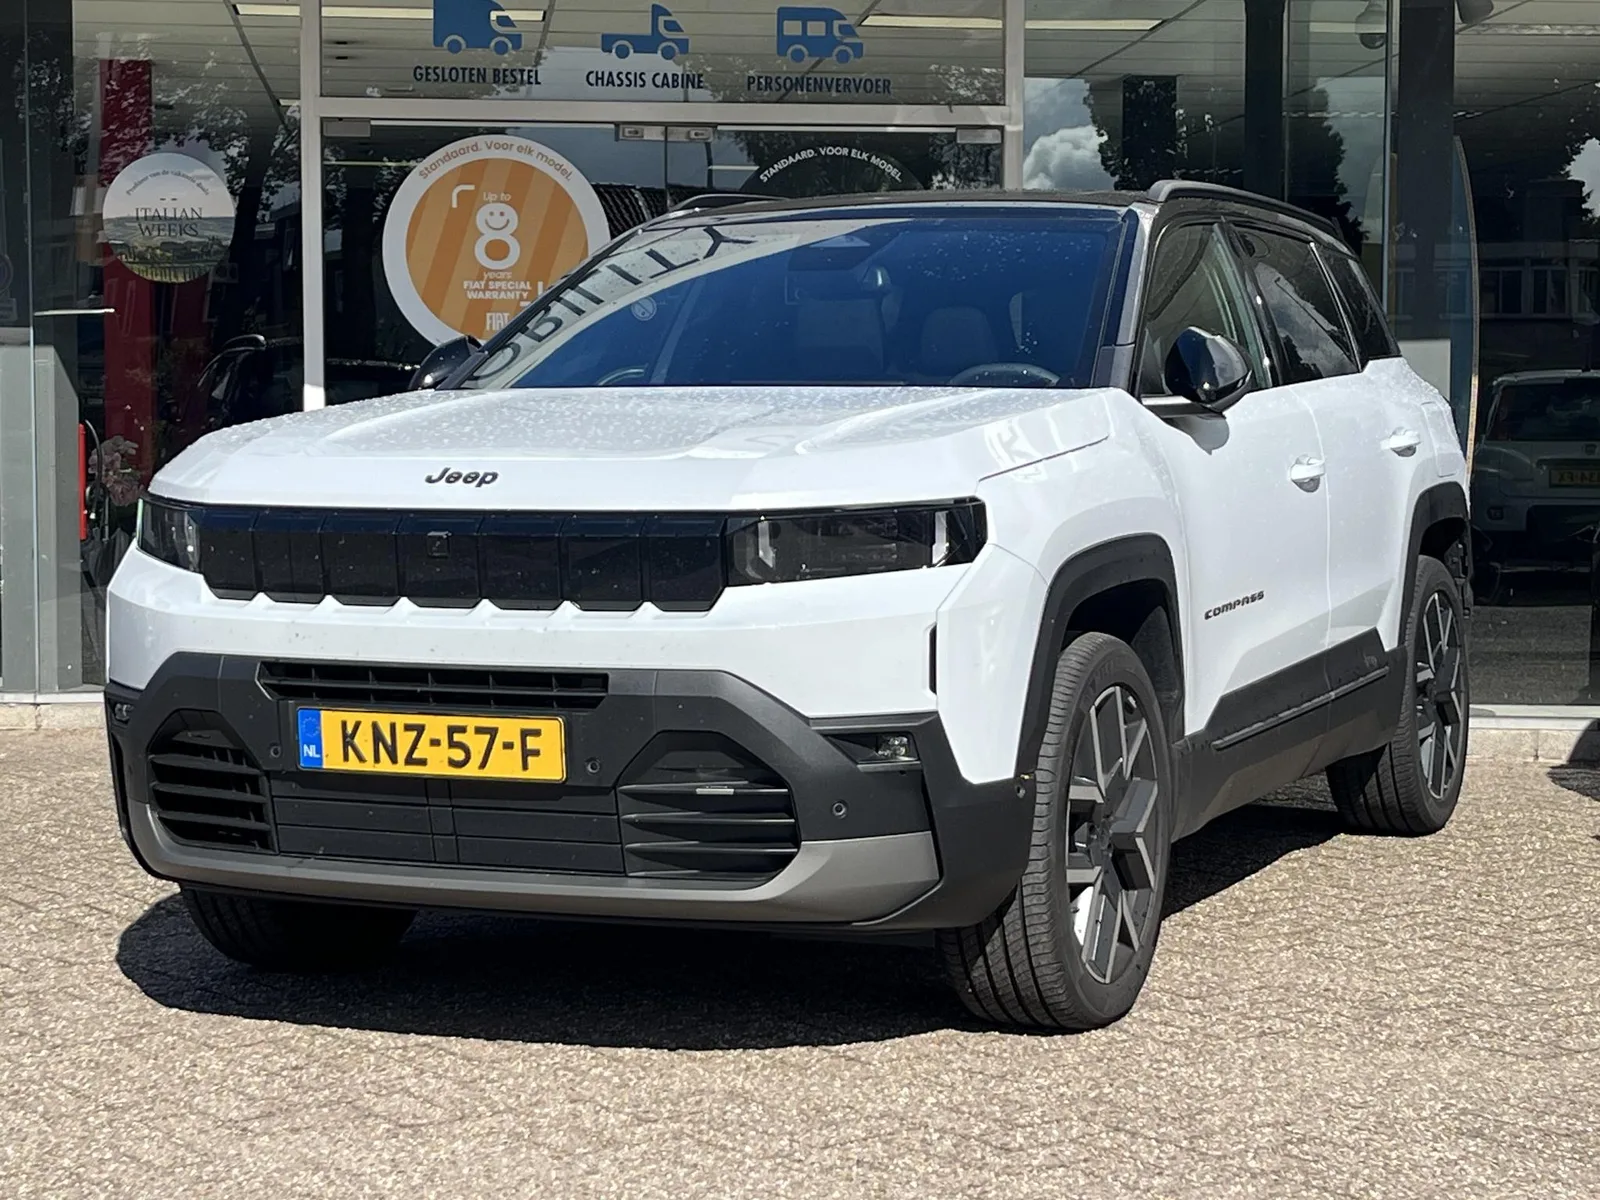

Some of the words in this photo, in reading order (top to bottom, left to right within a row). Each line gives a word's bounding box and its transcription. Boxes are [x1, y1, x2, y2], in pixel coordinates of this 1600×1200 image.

[412, 65, 487, 83] GESLOTEN
[492, 67, 542, 85] BESTEL
[585, 70, 647, 88] CHASSIS
[651, 72, 704, 89] CABINE
[746, 75, 892, 94] PERSONENVERVOER
[418, 142, 483, 180] Standaard.
[485, 140, 515, 151] Voor
[516, 143, 534, 156] elk
[535, 151, 574, 182] model.
[759, 149, 818, 183] STANDAARD.
[819, 146, 849, 156] VOOR
[850, 148, 869, 161] ELK
[870, 154, 903, 183] MODEL.
[483, 192, 498, 203] Up
[500, 192, 512, 202] to
[135, 207, 204, 221] ITALIAN
[138, 223, 199, 237] WEEKS
[474, 202, 521, 270] 8
[463, 281, 486, 290] FIAT
[488, 281, 532, 290] SPECIAL
[483, 271, 512, 283] years
[466, 290, 529, 299] WARRANTY
[486, 312, 511, 331] FIAT
[424, 466, 500, 488] Jeep
[1204, 590, 1265, 620] COMPASS
[303, 744, 321, 758] NL
[340, 719, 542, 772] KNZ-57-F
